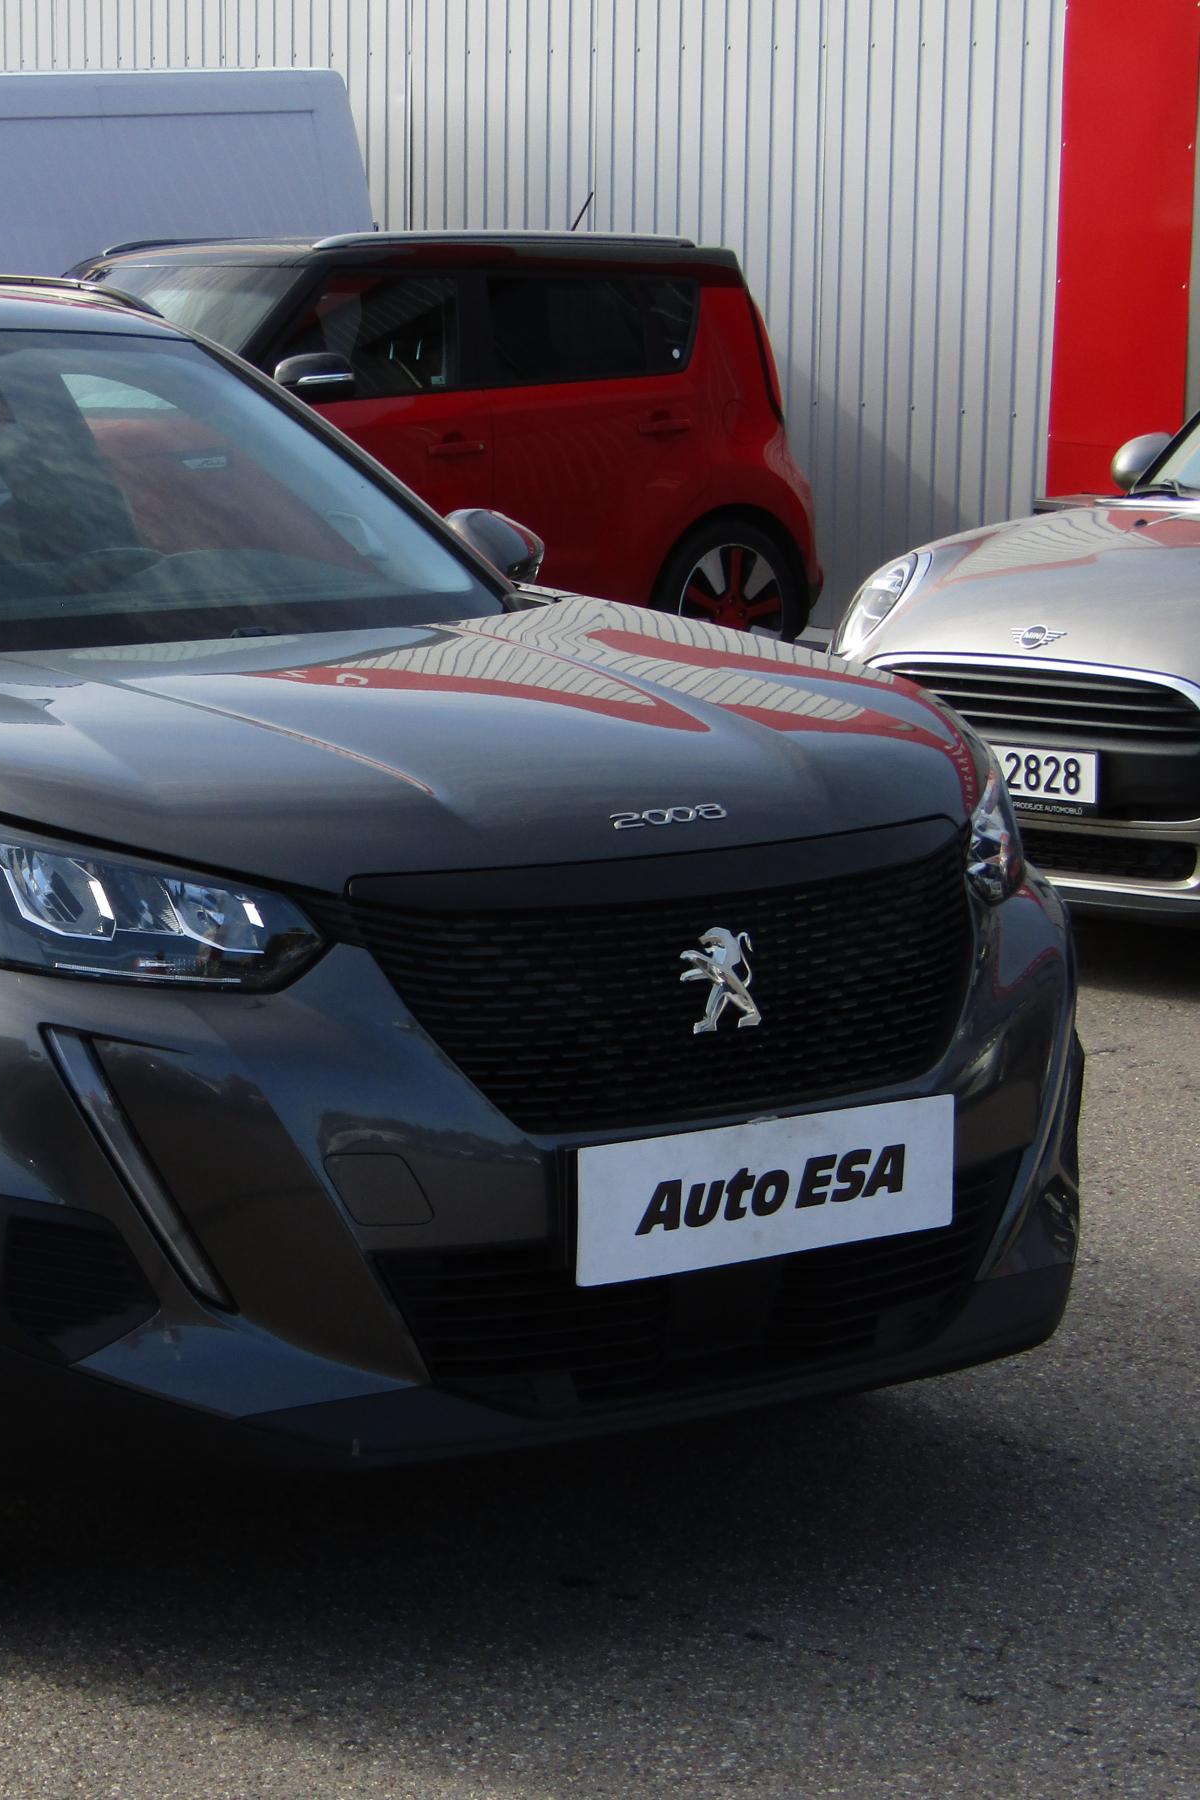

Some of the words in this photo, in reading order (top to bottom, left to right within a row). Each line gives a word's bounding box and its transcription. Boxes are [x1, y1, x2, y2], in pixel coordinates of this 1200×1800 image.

[1005, 752, 1081, 796] 2828
[609, 803, 728, 830] 2008
[1012, 801, 1044, 812] PRODEJCE
[635, 1167, 789, 1235] Auto
[795, 1143, 906, 1208] ESA
